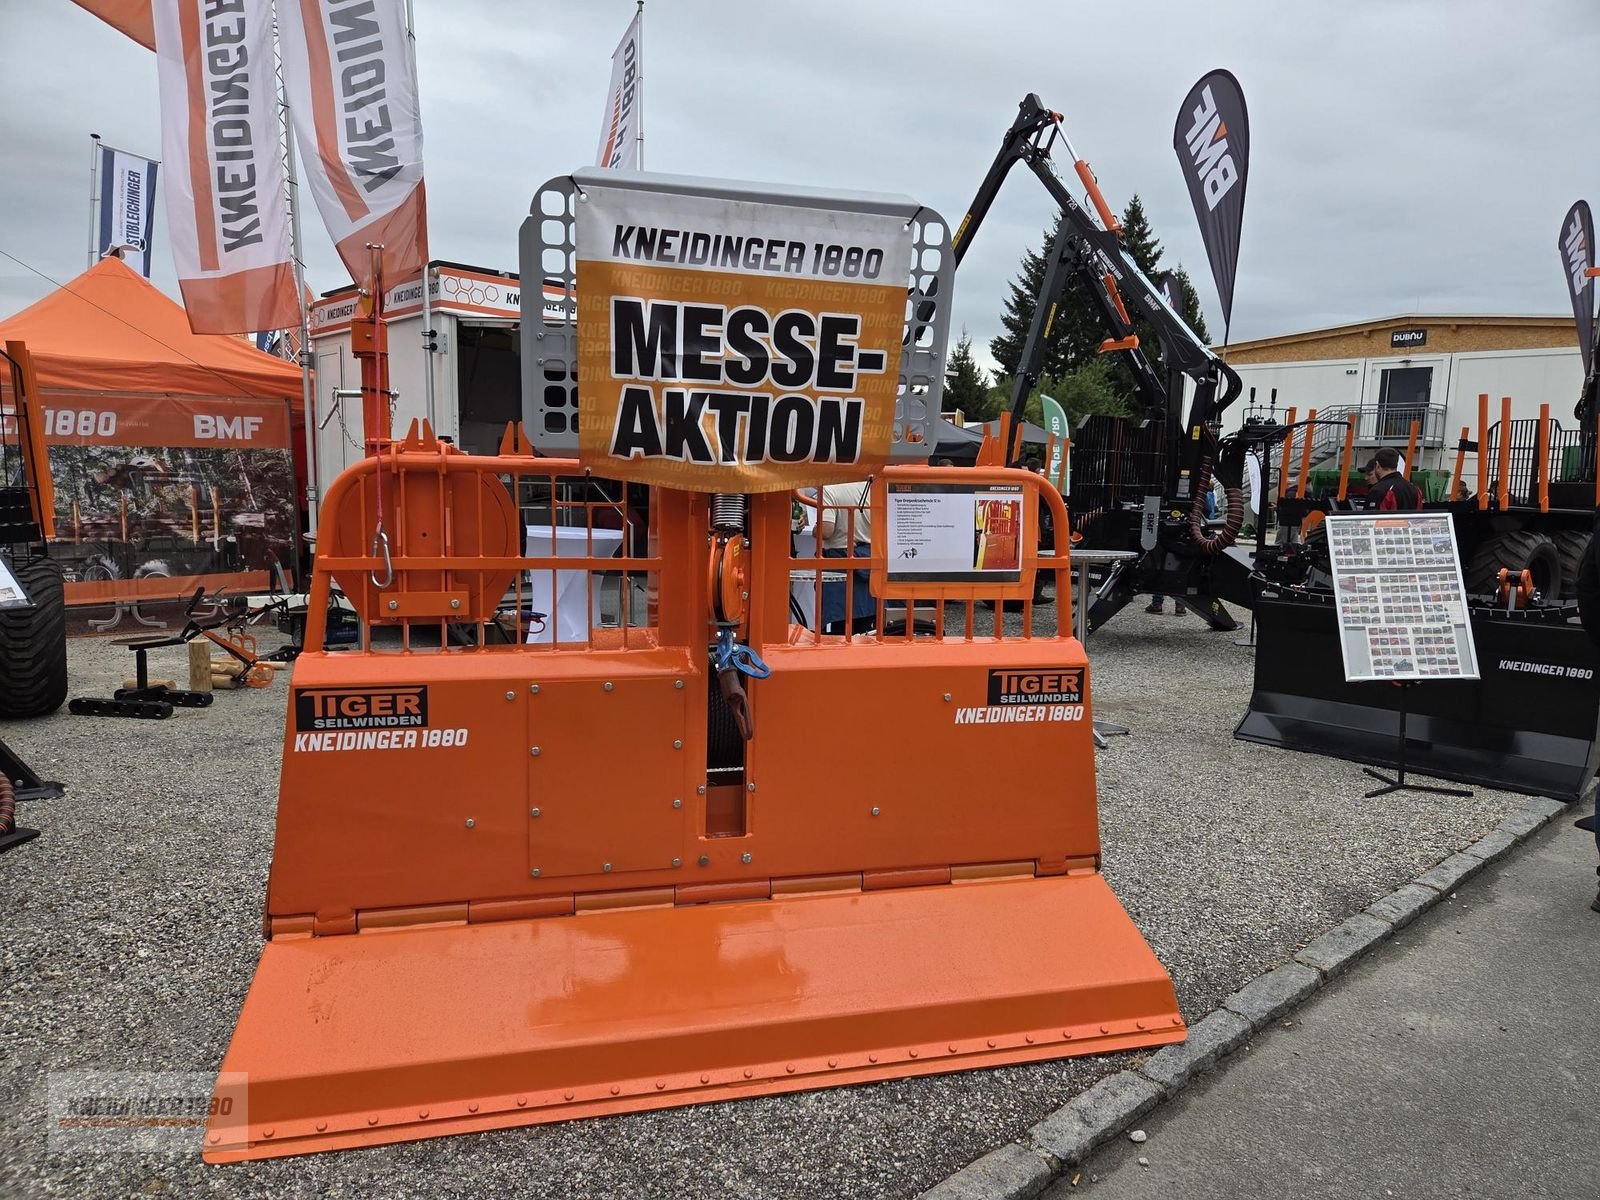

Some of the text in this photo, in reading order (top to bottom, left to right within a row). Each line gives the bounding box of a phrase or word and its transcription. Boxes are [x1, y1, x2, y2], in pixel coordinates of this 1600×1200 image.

[612, 225, 884, 280] KNEIDINGER 1880
[1143, 293, 1161, 311] BMF
[614, 296, 886, 390] MESSE-
[44, 410, 117, 436] 1880
[194, 415, 263, 440] BMF
[611, 391, 863, 466] AKTION
[1146, 513, 1155, 534] BMF
[1499, 659, 1593, 679] KNEIDINGER 1880
[992, 669, 1082, 694] TIGER
[300, 688, 424, 718] TIGER
[1000, 694, 1079, 703] SEILWINDEN
[314, 716, 421, 728] SEILWINDEN
[955, 706, 1084, 724] KNEIDINGER 1880
[294, 728, 468, 752] KNEIDINGER 1880
